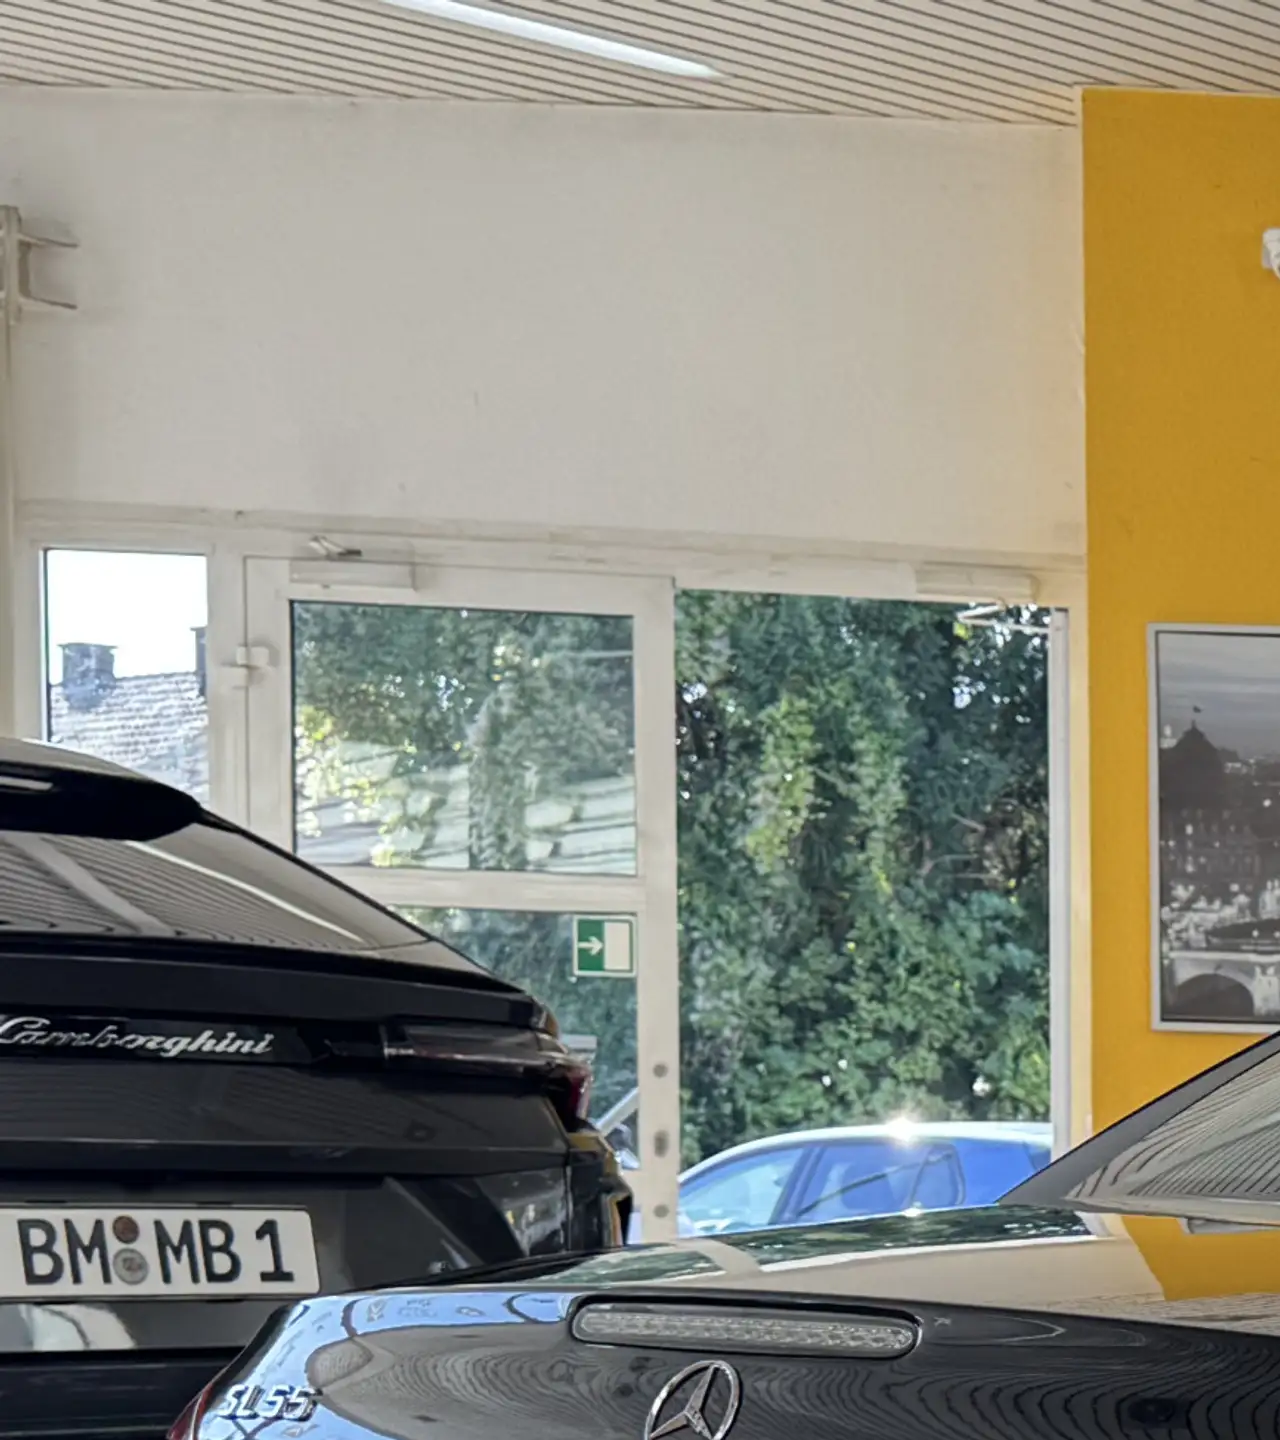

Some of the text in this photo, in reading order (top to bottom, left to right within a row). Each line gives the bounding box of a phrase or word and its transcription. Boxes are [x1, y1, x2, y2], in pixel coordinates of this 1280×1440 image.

[0, 1016, 274, 1057] Lamborghini
[17, 1218, 295, 1285] BM MB 1
